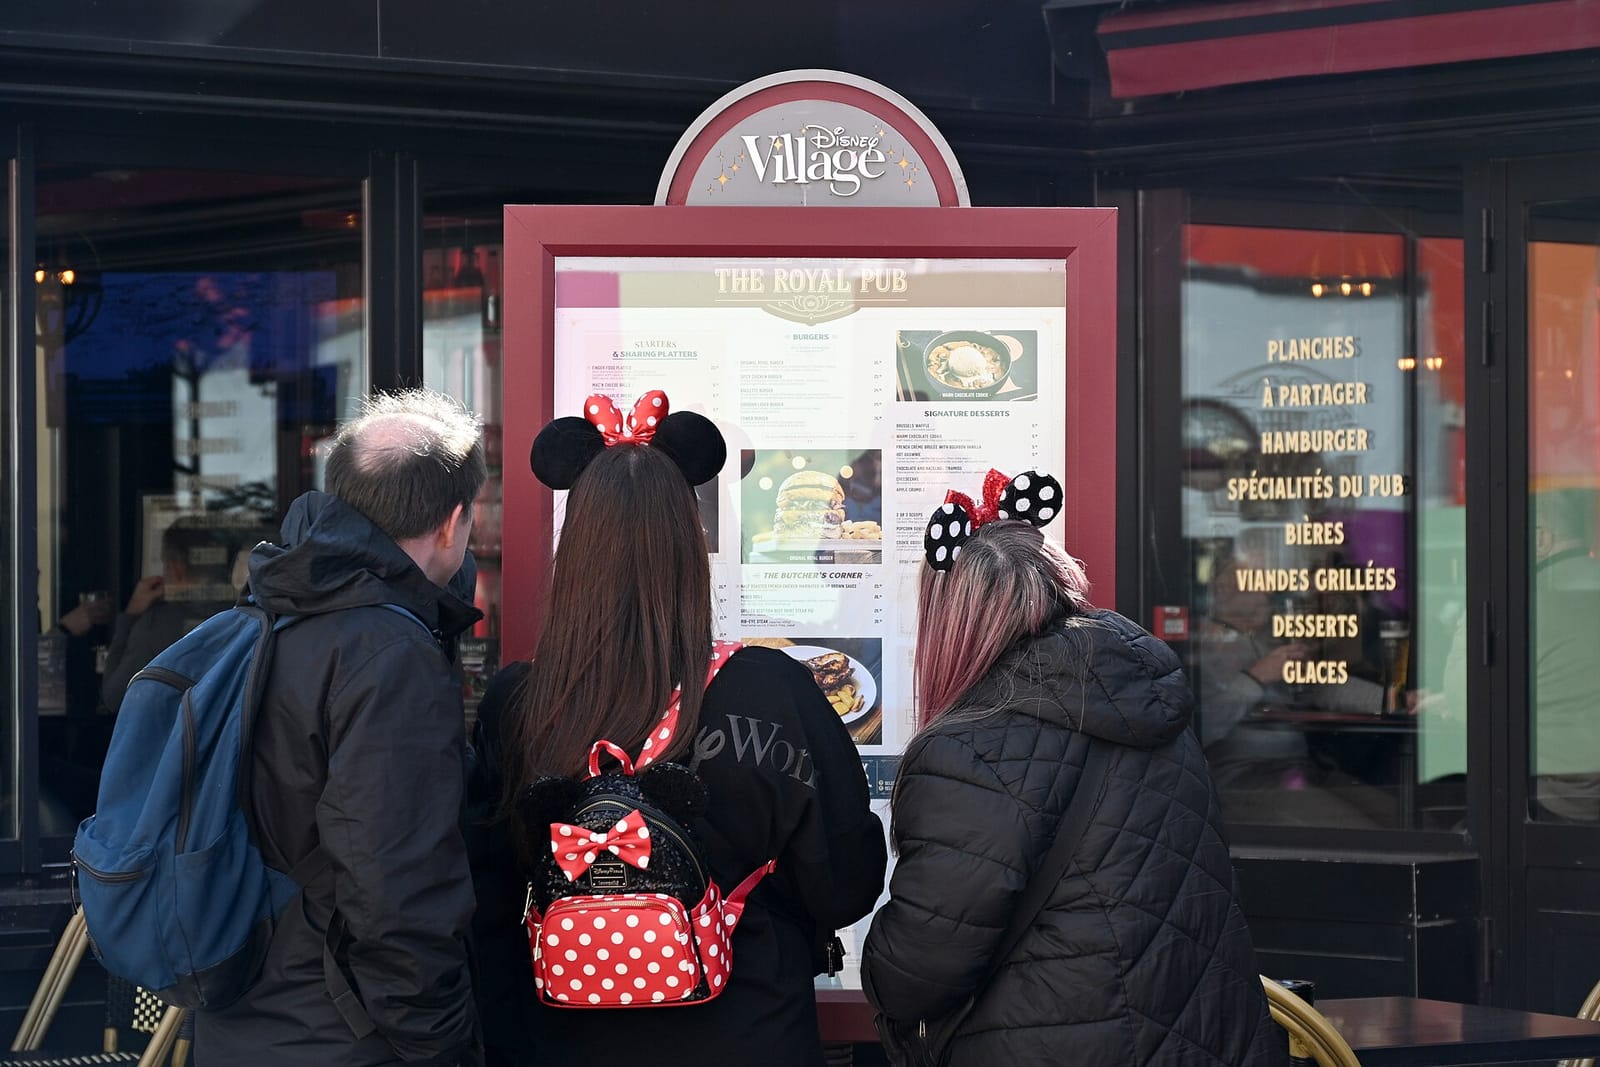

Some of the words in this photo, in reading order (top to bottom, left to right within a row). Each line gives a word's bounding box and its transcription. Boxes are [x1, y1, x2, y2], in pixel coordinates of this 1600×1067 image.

[805, 124, 879, 156] Disney
[741, 132, 886, 197] Village
[714, 267, 766, 294] THE
[773, 267, 852, 294] ROYAL
[859, 267, 908, 294] PUB
[634, 340, 677, 349] STARTERS
[792, 333, 830, 341] BURGERS
[1267, 335, 1355, 363] PLANCHES
[620, 350, 657, 358] SHARING
[657, 350, 698, 358] PLATTERS
[1262, 378, 1274, 408] À
[1279, 381, 1367, 407] PARTAGER
[1261, 429, 1369, 455] HAMBURGER
[1227, 468, 1334, 501] SPÉCIALITÉS
[1339, 475, 1363, 499] DU
[1369, 473, 1406, 498] PUB
[1285, 514, 1345, 545] BIÈRES
[763, 571, 779, 579] THE
[780, 571, 827, 579] BUTCHER'S
[828, 571, 863, 579] CORNER
[1236, 568, 1310, 592] VIANDES
[1314, 560, 1397, 591] GRILLÉES
[1272, 614, 1359, 638] DESSERTS
[1282, 660, 1349, 685] GLACES
